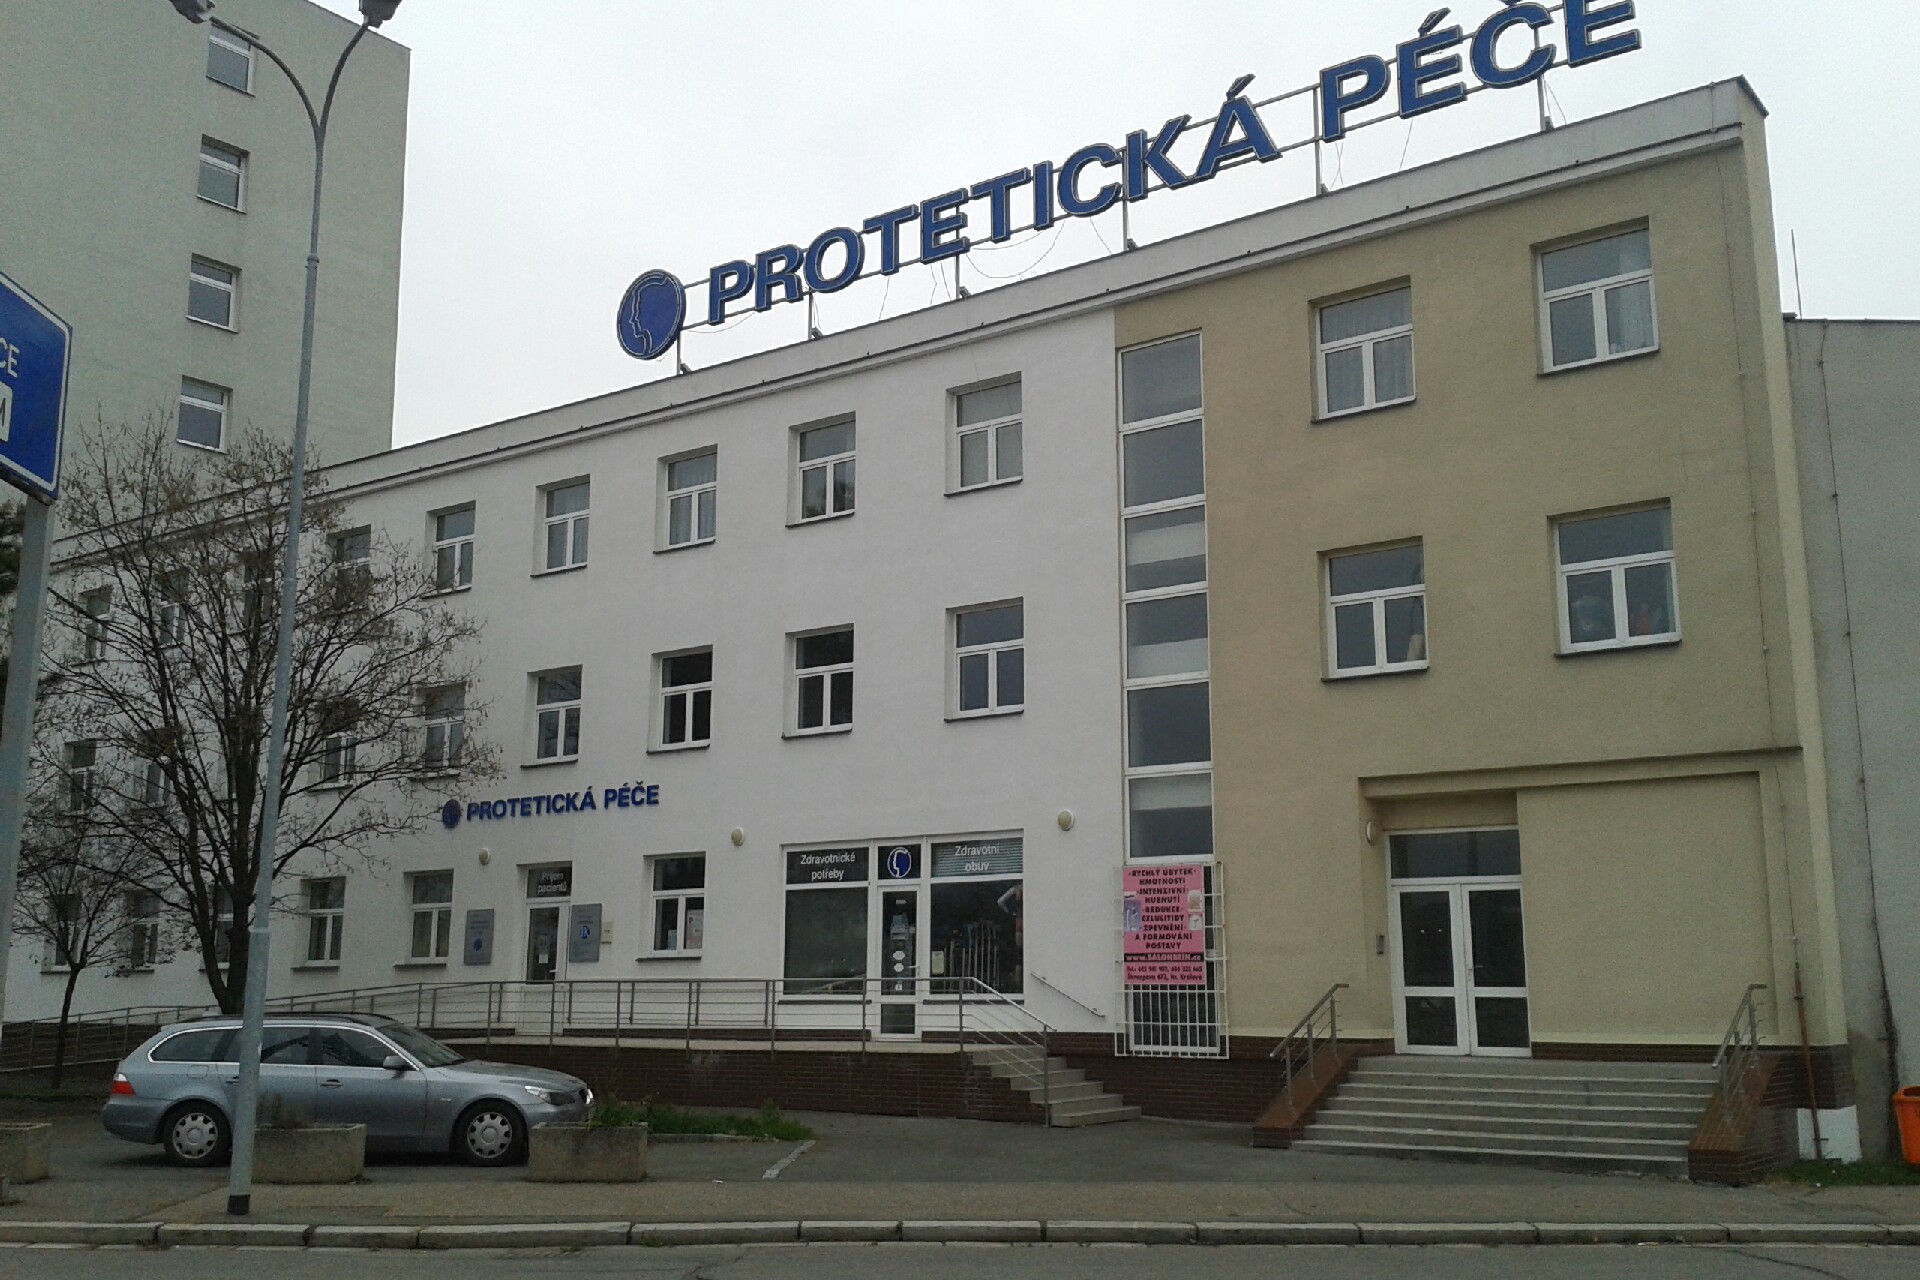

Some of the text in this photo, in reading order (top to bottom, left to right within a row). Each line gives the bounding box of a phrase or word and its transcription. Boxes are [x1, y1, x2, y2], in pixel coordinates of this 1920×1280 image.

[708, 0, 1642, 324] PROTETICKÁ PÉČE
[467, 780, 660, 821] PROTETICKÁ PÉČE
[800, 851, 856, 865] Zdravotnické
[964, 862, 990, 872] obuv
[811, 868, 845, 881] potřeby
